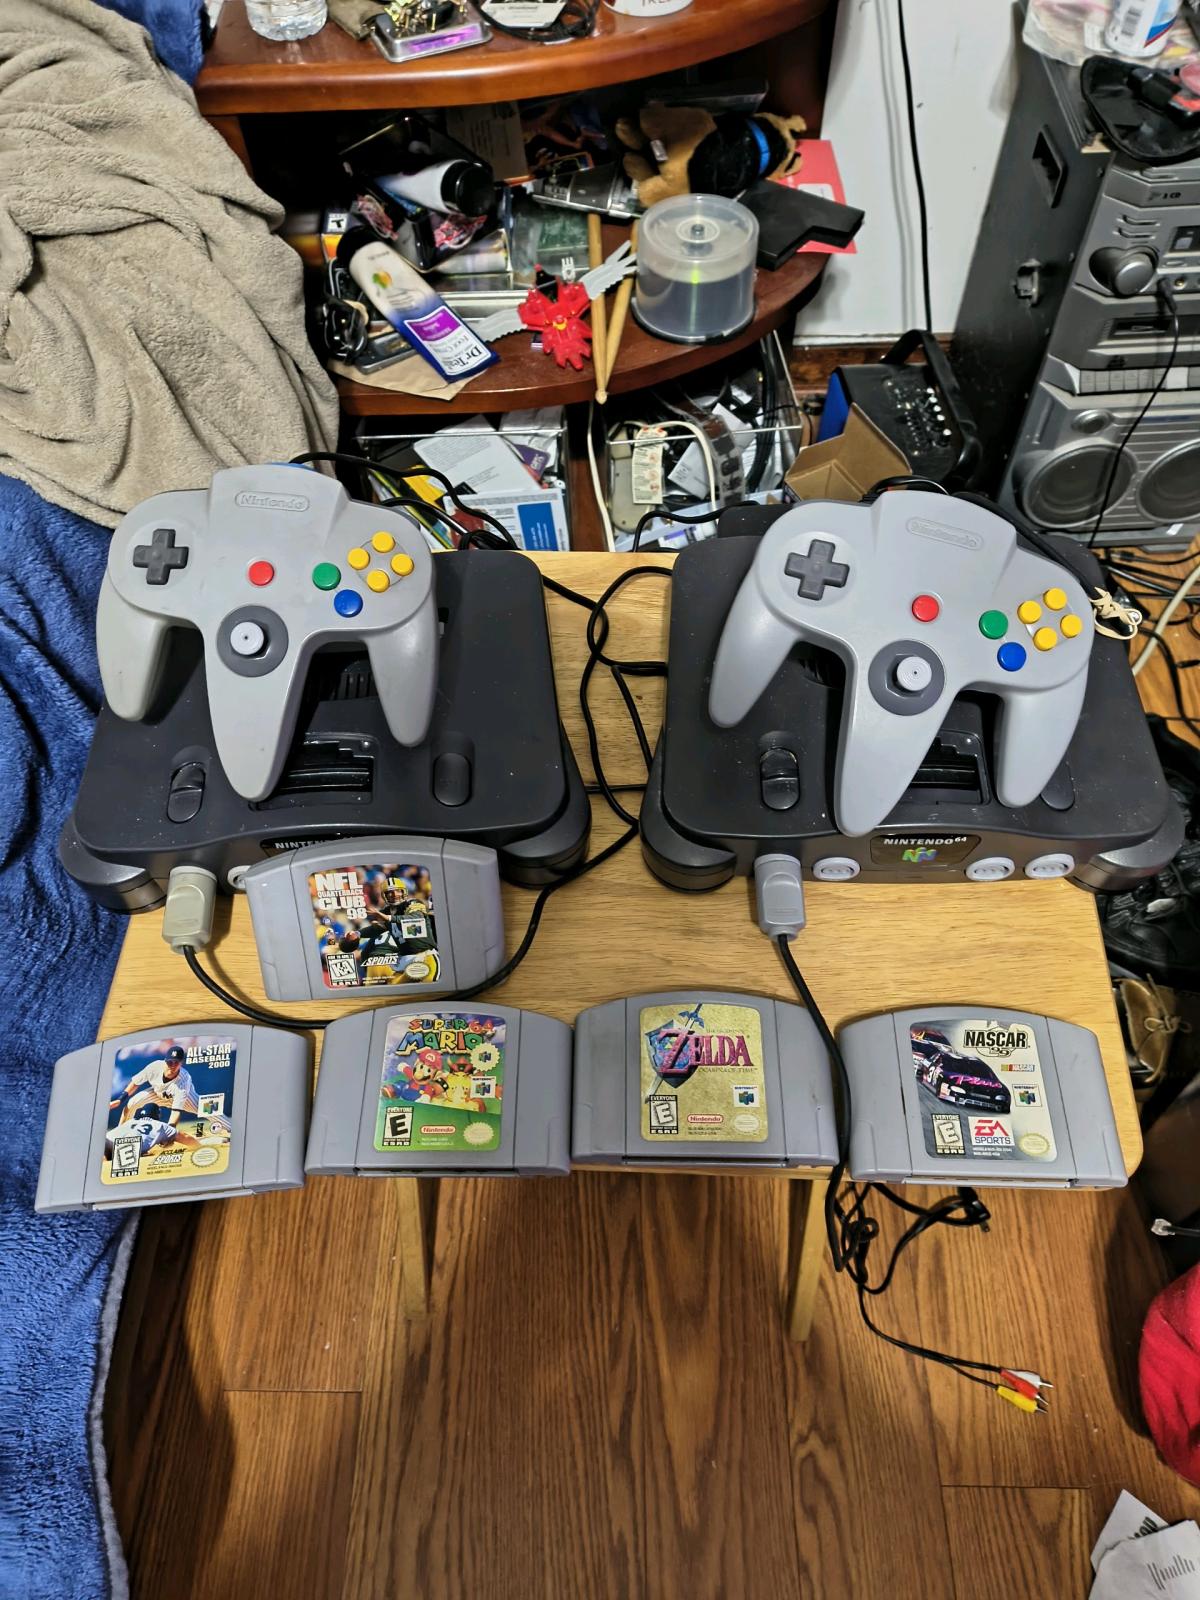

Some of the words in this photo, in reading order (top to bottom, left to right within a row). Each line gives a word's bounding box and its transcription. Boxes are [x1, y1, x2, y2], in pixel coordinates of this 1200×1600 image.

[466, 345, 482, 359] Dr
[241, 494, 304, 509] Nintendo
[314, 872, 364, 891] NFL
[317, 889, 364, 899] QUARTERBACK
[319, 895, 366, 910] CLUB
[346, 907, 368, 920] 98
[364, 956, 399, 967] SPORTS
[408, 1018, 467, 1031] SUPER
[469, 1020, 494, 1034] 64
[396, 1031, 484, 1052] MARIO
[965, 1031, 1026, 1048] NASCAR
[187, 1043, 231, 1058] ALL-STAR
[657, 1028, 754, 1073] ZELDA
[186, 1054, 230, 1065] BASEBALL
[208, 1060, 230, 1069] 2000
[655, 1103, 674, 1124] E
[390, 1114, 408, 1136] E
[938, 1121, 960, 1144] E
[974, 1119, 1010, 1137] EA
[115, 1137, 140, 1145] EVERYONE
[975, 1136, 1011, 1145] SPORTS
[119, 1144, 136, 1167] E
